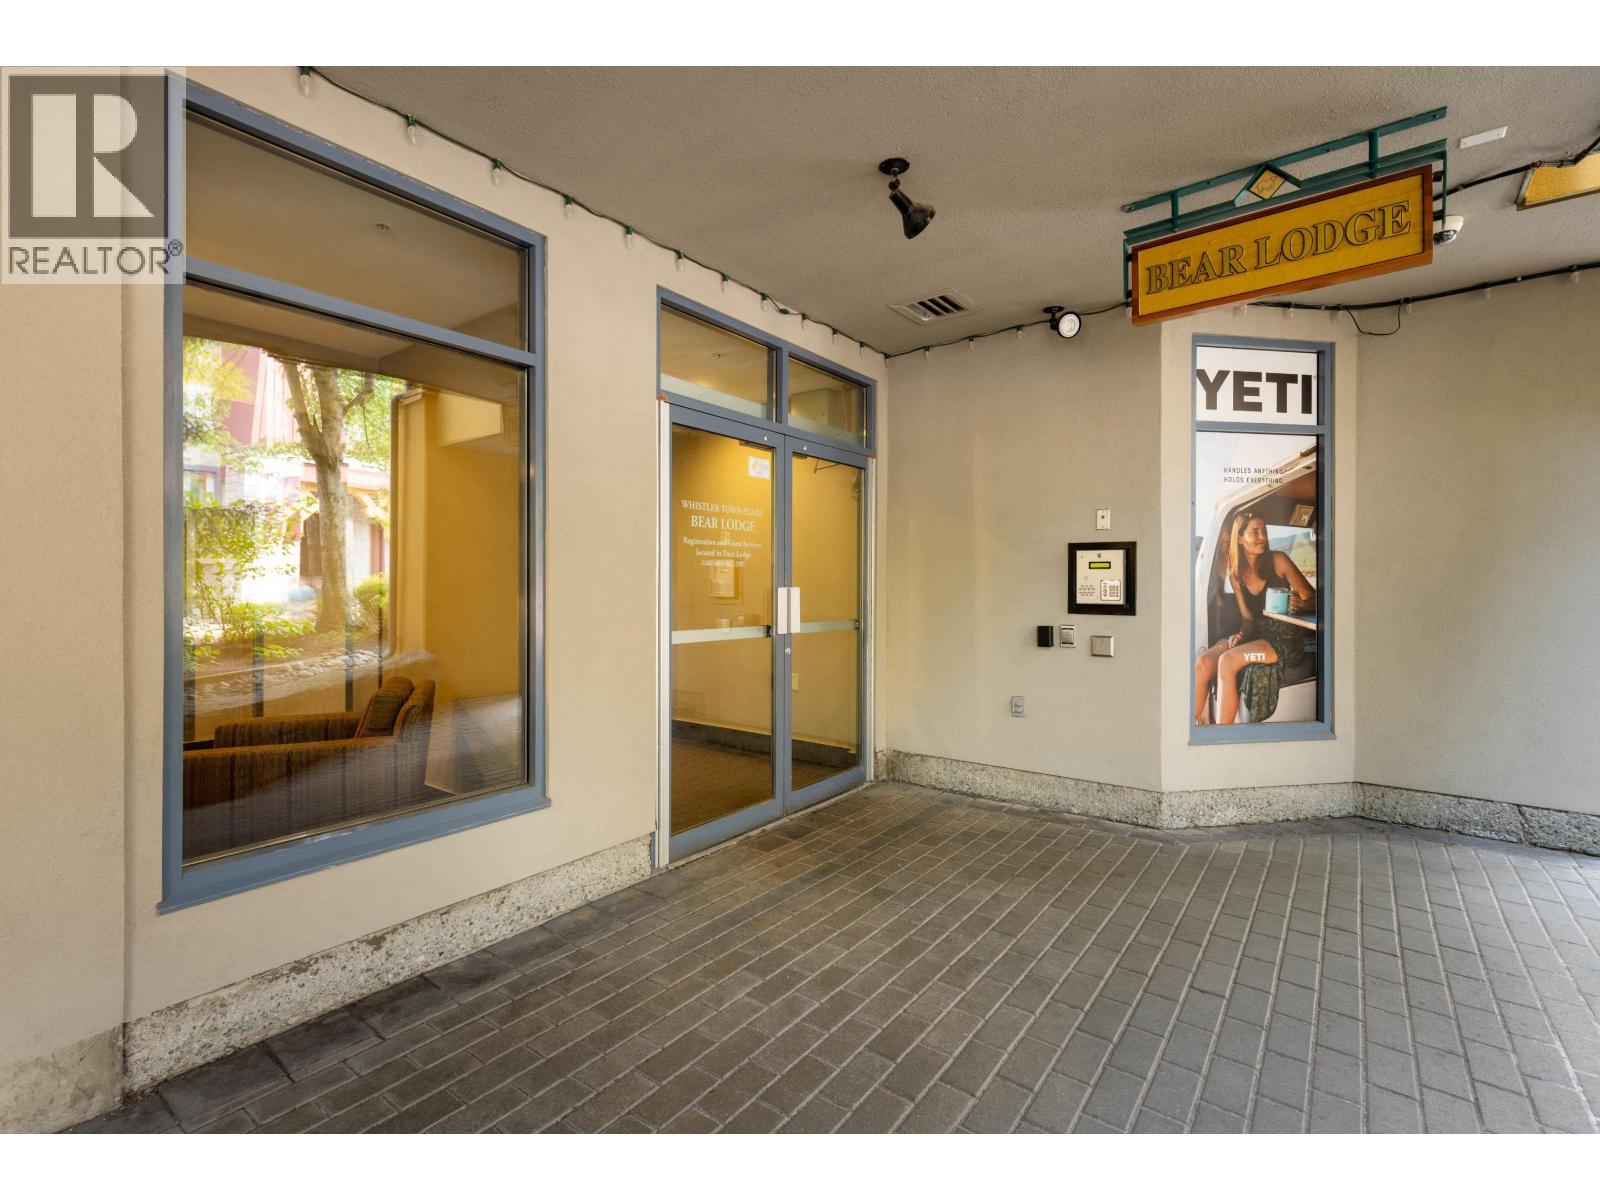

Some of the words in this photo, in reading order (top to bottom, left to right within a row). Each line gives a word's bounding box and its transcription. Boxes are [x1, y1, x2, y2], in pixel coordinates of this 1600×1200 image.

[1146, 244, 1248, 295] BEAR
[1254, 200, 1413, 270] LODGE
[1196, 368, 1313, 415] YETI
[1253, 467, 1283, 475] ANYTHING
[681, 500, 720, 512] WHISTLER
[721, 504, 742, 515] TOWN
[691, 516, 718, 528] BEAR
[721, 519, 754, 532] LODGE
[1244, 653, 1265, 662] YETI
